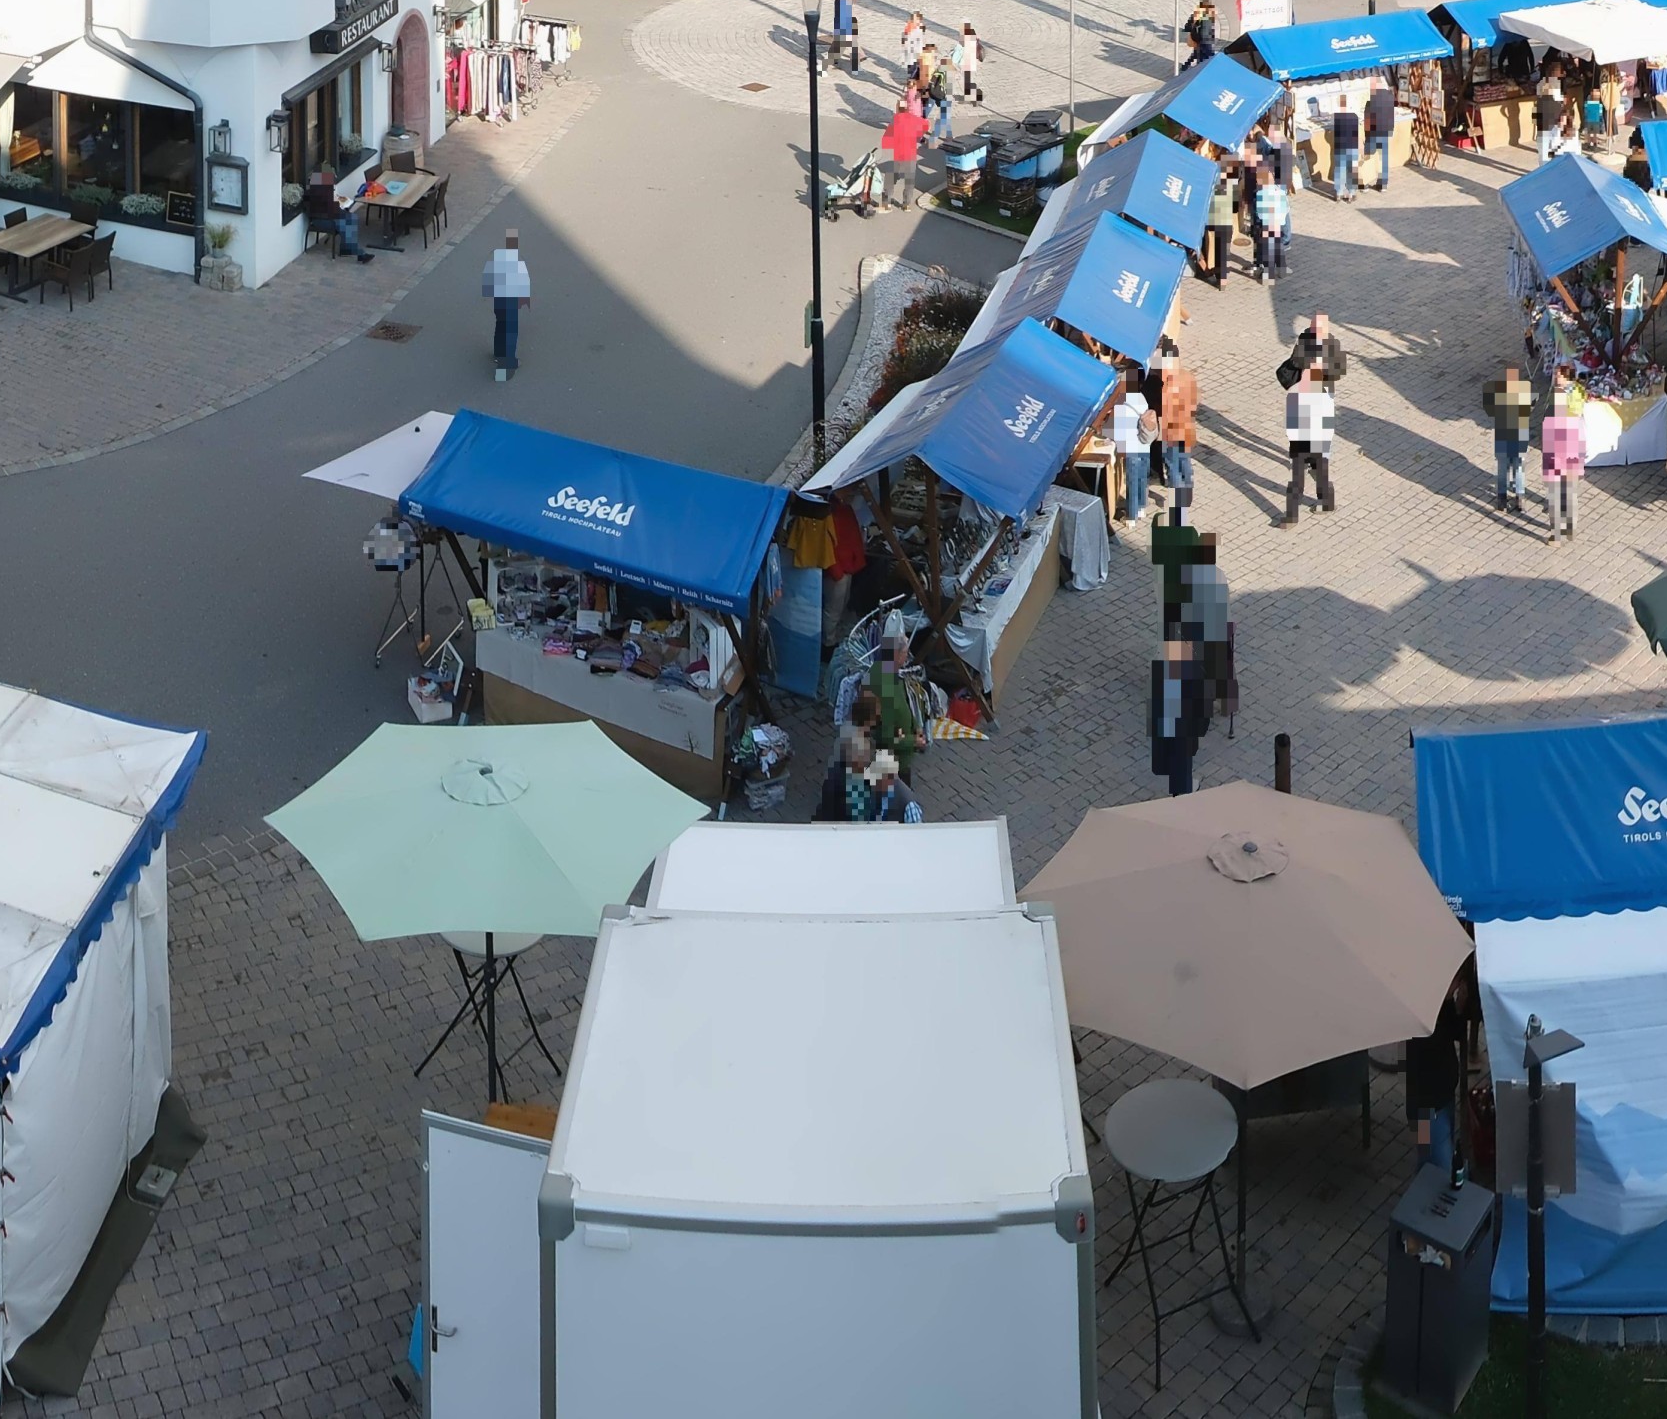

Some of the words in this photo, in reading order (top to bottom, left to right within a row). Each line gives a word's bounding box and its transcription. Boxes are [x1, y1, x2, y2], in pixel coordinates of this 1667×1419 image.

[1331, 34, 1377, 50] Seefeld
[1003, 394, 1045, 439] Seefeld
[547, 486, 636, 527] Seefeld
[542, 509, 567, 523] TIROLS
[568, 516, 622, 538] HOCHPLATEAU
[1623, 831, 1662, 844] TIROLS
